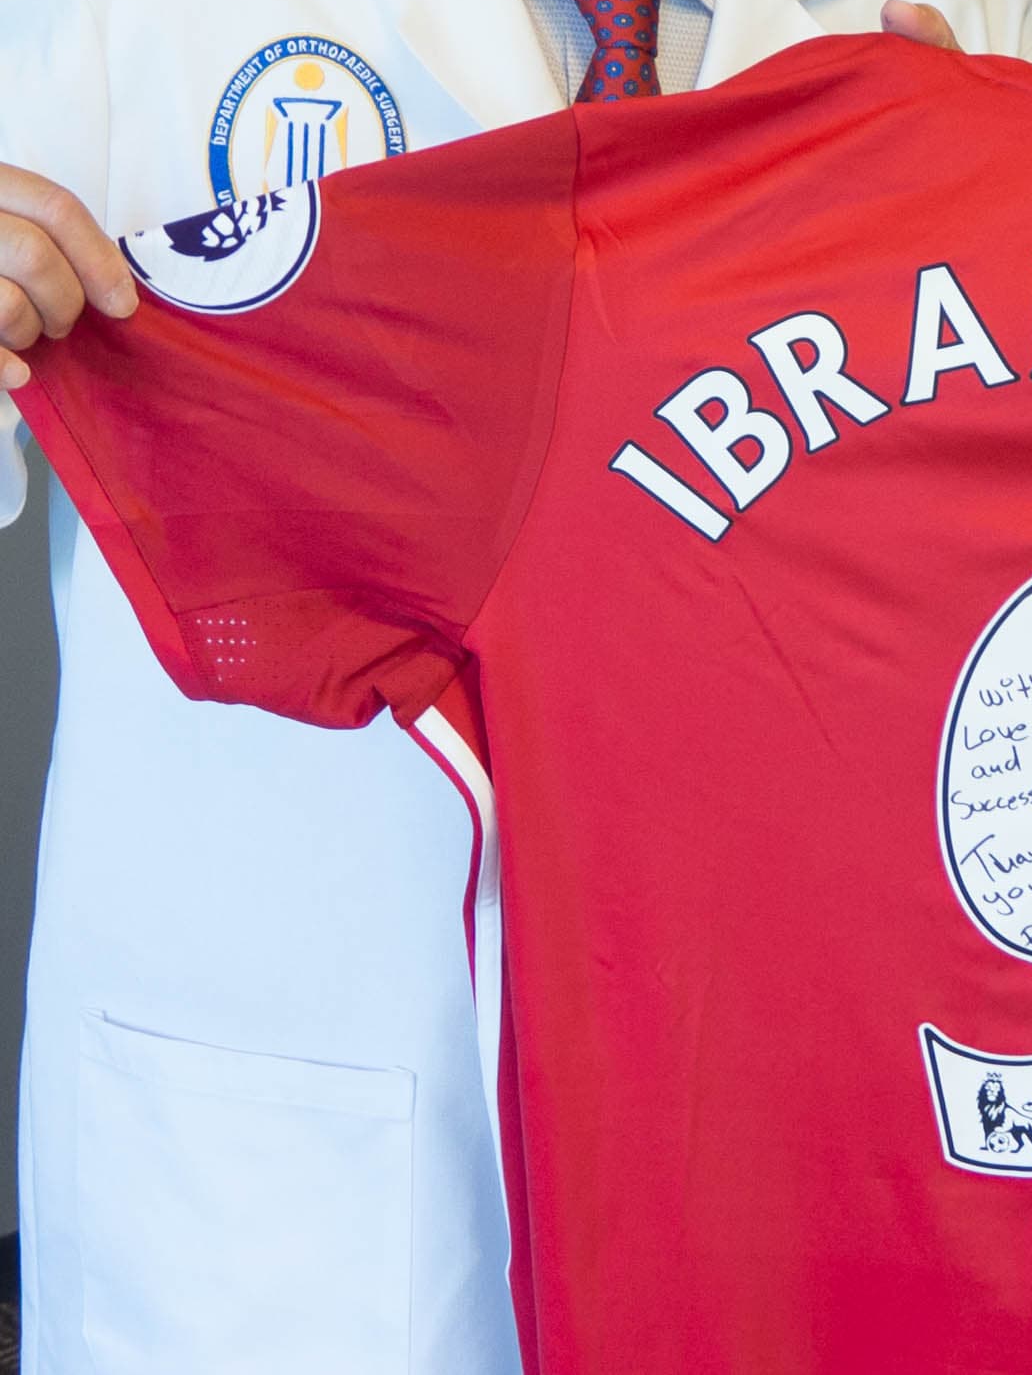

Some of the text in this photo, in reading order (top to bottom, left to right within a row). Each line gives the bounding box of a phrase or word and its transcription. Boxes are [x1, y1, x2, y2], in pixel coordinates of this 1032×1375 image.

[213, 39, 403, 153] DEPARTMENT OF ORTHOPAEDIC SURGERY
[964, 723, 1029, 750] Love
[971, 745, 1022, 779] and
